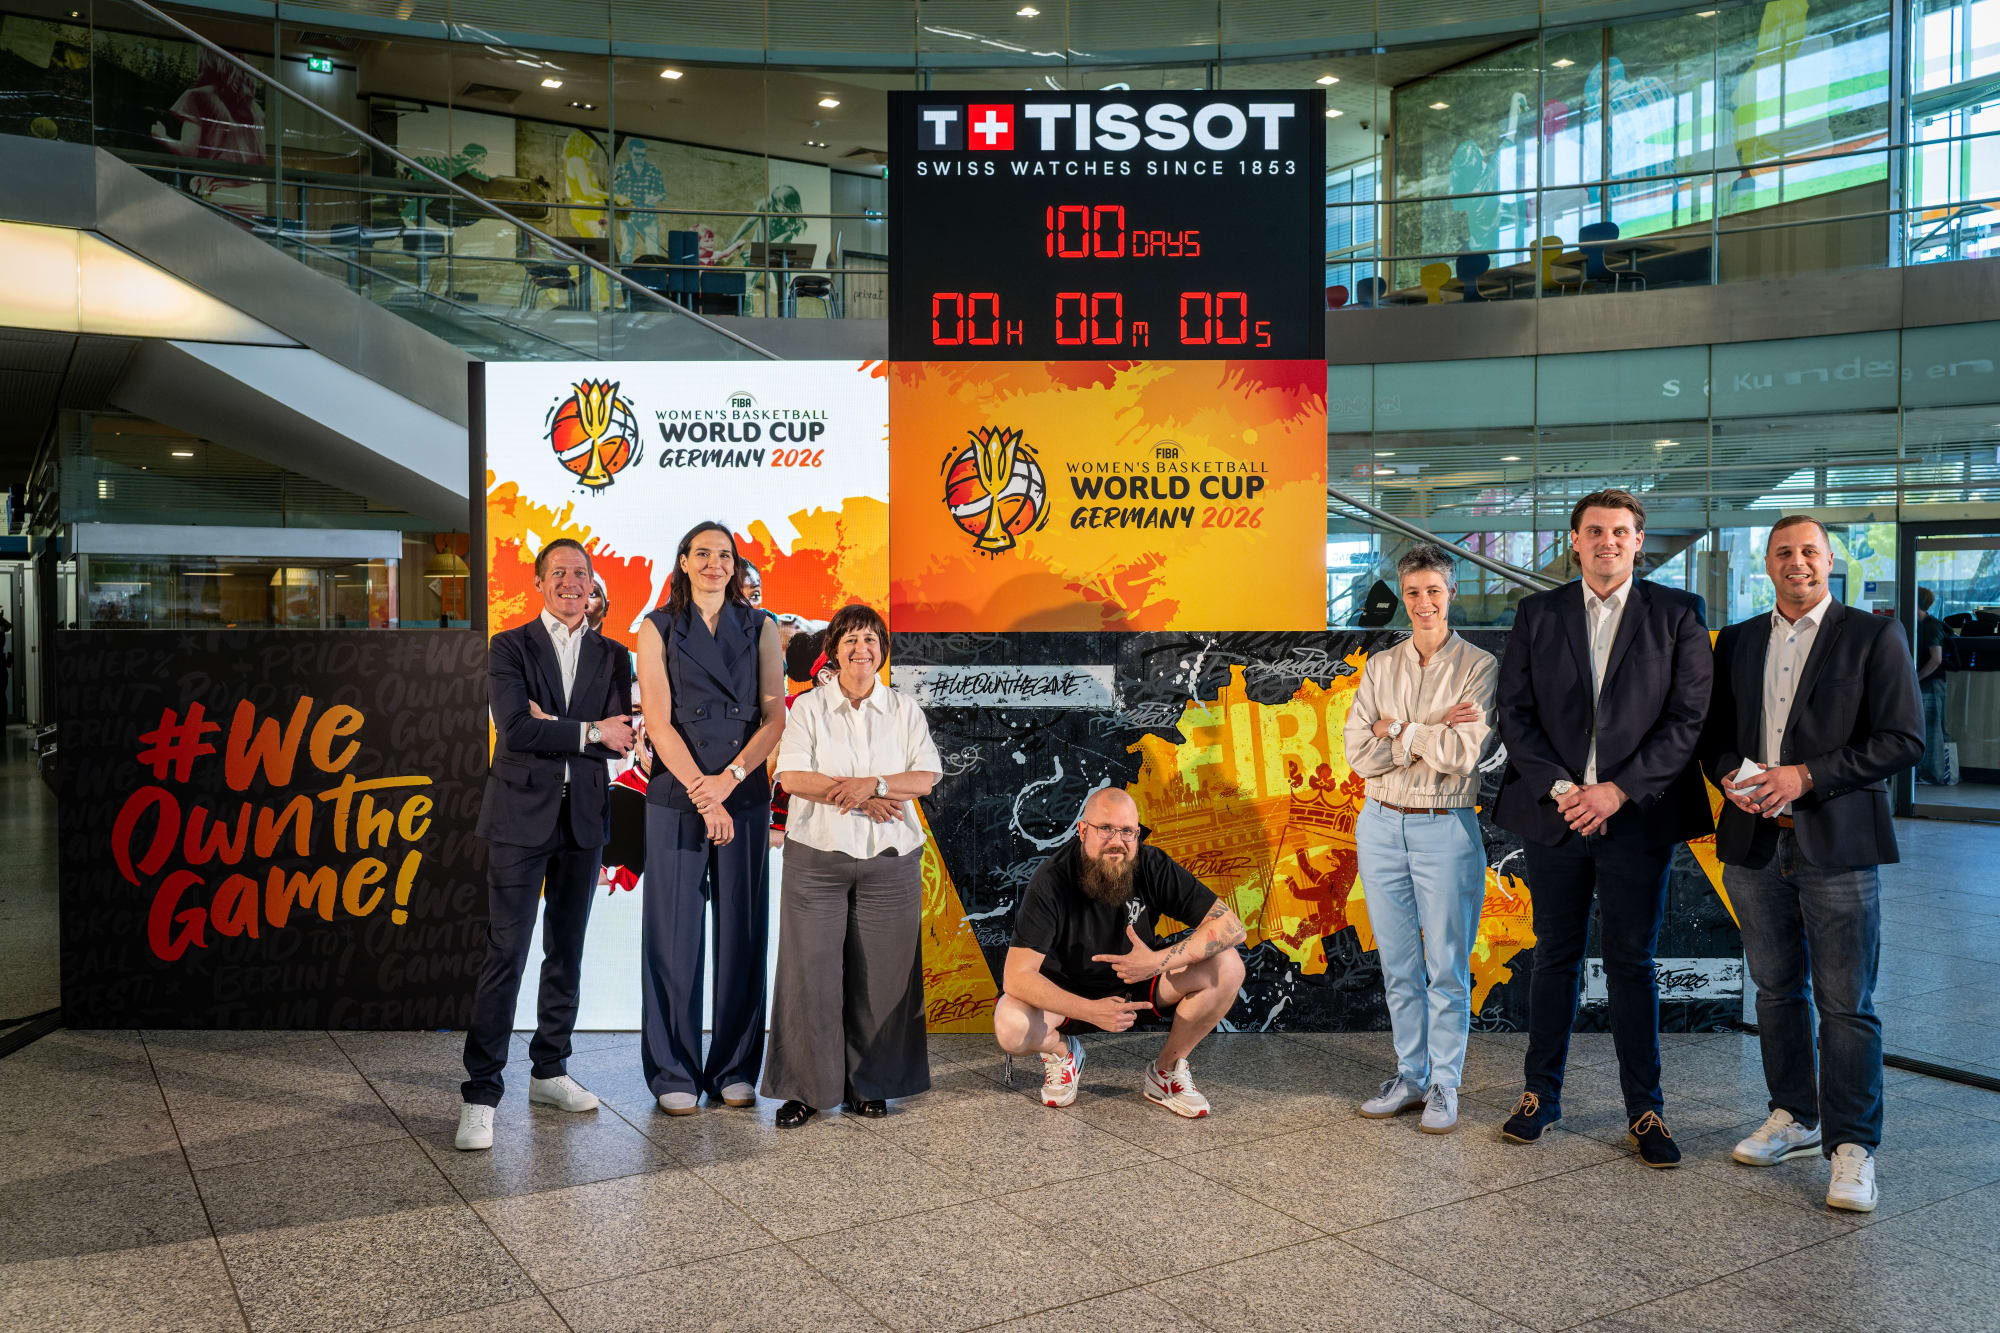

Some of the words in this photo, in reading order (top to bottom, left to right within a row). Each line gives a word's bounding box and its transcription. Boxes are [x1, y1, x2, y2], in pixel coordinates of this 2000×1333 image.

[1024, 103, 1296, 151] TISSOT
[917, 161, 996, 176] SWISS
[1011, 161, 1131, 176] WATCHES
[1147, 161, 1223, 175] SINCE
[1239, 161, 1296, 175] 1853
[1046, 205, 1125, 258] 100
[1132, 231, 1201, 257] DAYS
[932, 292, 1000, 346] 00
[1055, 292, 1123, 346] 00
[1180, 291, 1248, 345] 00
[655, 410, 727, 420] WOMEN'S
[732, 409, 829, 420] BASKETBALL
[731, 398, 752, 408] FIBA
[659, 422, 762, 443] WORLD
[769, 421, 825, 442] CUP
[659, 449, 766, 469] GERMANY
[770, 449, 824, 468] 2026
[1156, 447, 1179, 459] FIBA
[1066, 462, 1150, 473] WOMEN'S
[1156, 461, 1269, 473] BASKETBALL
[1071, 476, 1191, 500] WORLD
[1199, 475, 1265, 500] CUP
[1070, 506, 1196, 530] GERMANY
[1201, 506, 1264, 529] 2026
[259, 640, 382, 681] PRIDE
[137, 696, 365, 791] #We
[147, 850, 423, 961] Game!
